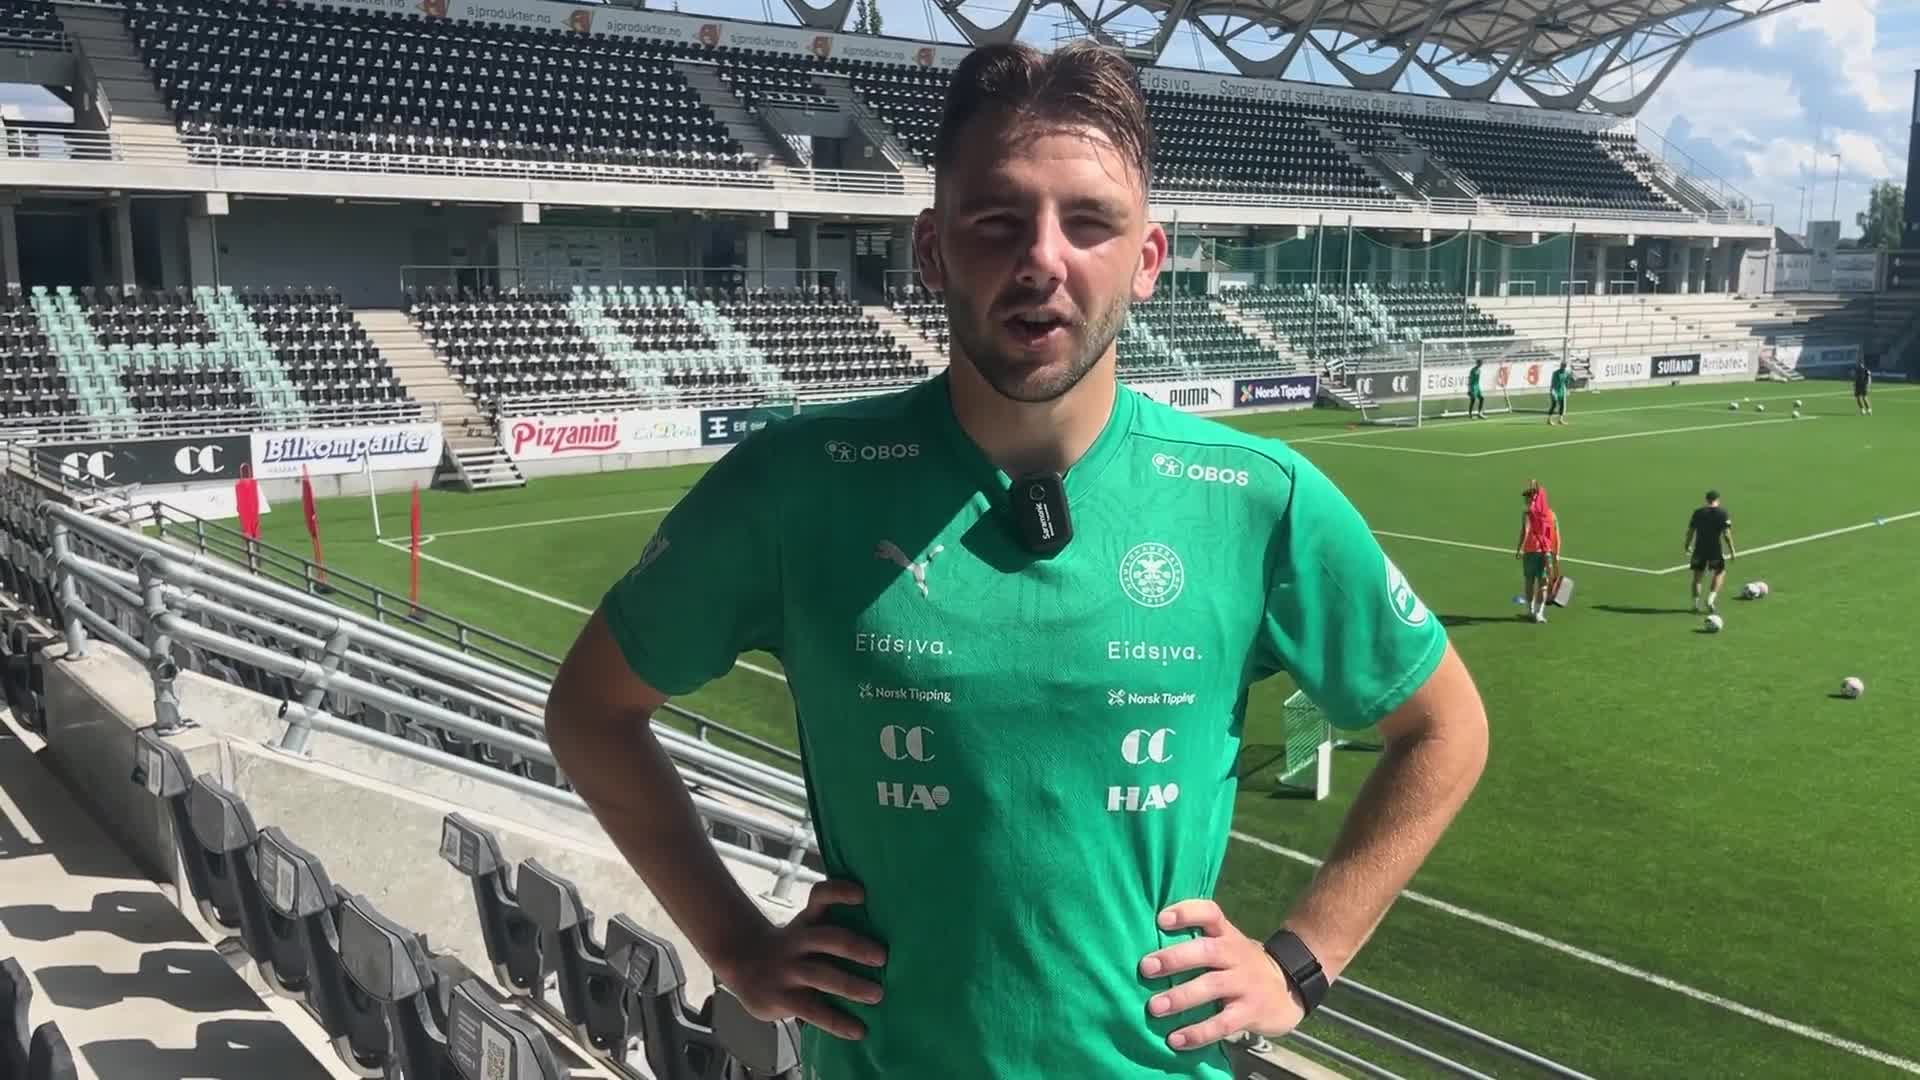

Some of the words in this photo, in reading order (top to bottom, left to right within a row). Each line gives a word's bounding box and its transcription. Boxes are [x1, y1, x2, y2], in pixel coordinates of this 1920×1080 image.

[467, 6, 550, 24] ajprodukter.no
[607, 20, 681, 37] ajprodukter.no
[1170, 387, 1209, 407] PUMA
[1254, 385, 1280, 399] Norsk
[1280, 383, 1311, 399] Tipping
[511, 412, 621, 455] Pizzanini
[174, 444, 225, 476] CC
[861, 443, 921, 460] OBOS
[1186, 464, 1249, 487] OBOS
[875, 687, 907, 699] Norsk
[908, 687, 952, 703] Tipping
[1127, 692, 1160, 705] Norsk
[1161, 692, 1198, 706] Tipping
[879, 724, 936, 762] CC
[1121, 727, 1177, 765] CC
